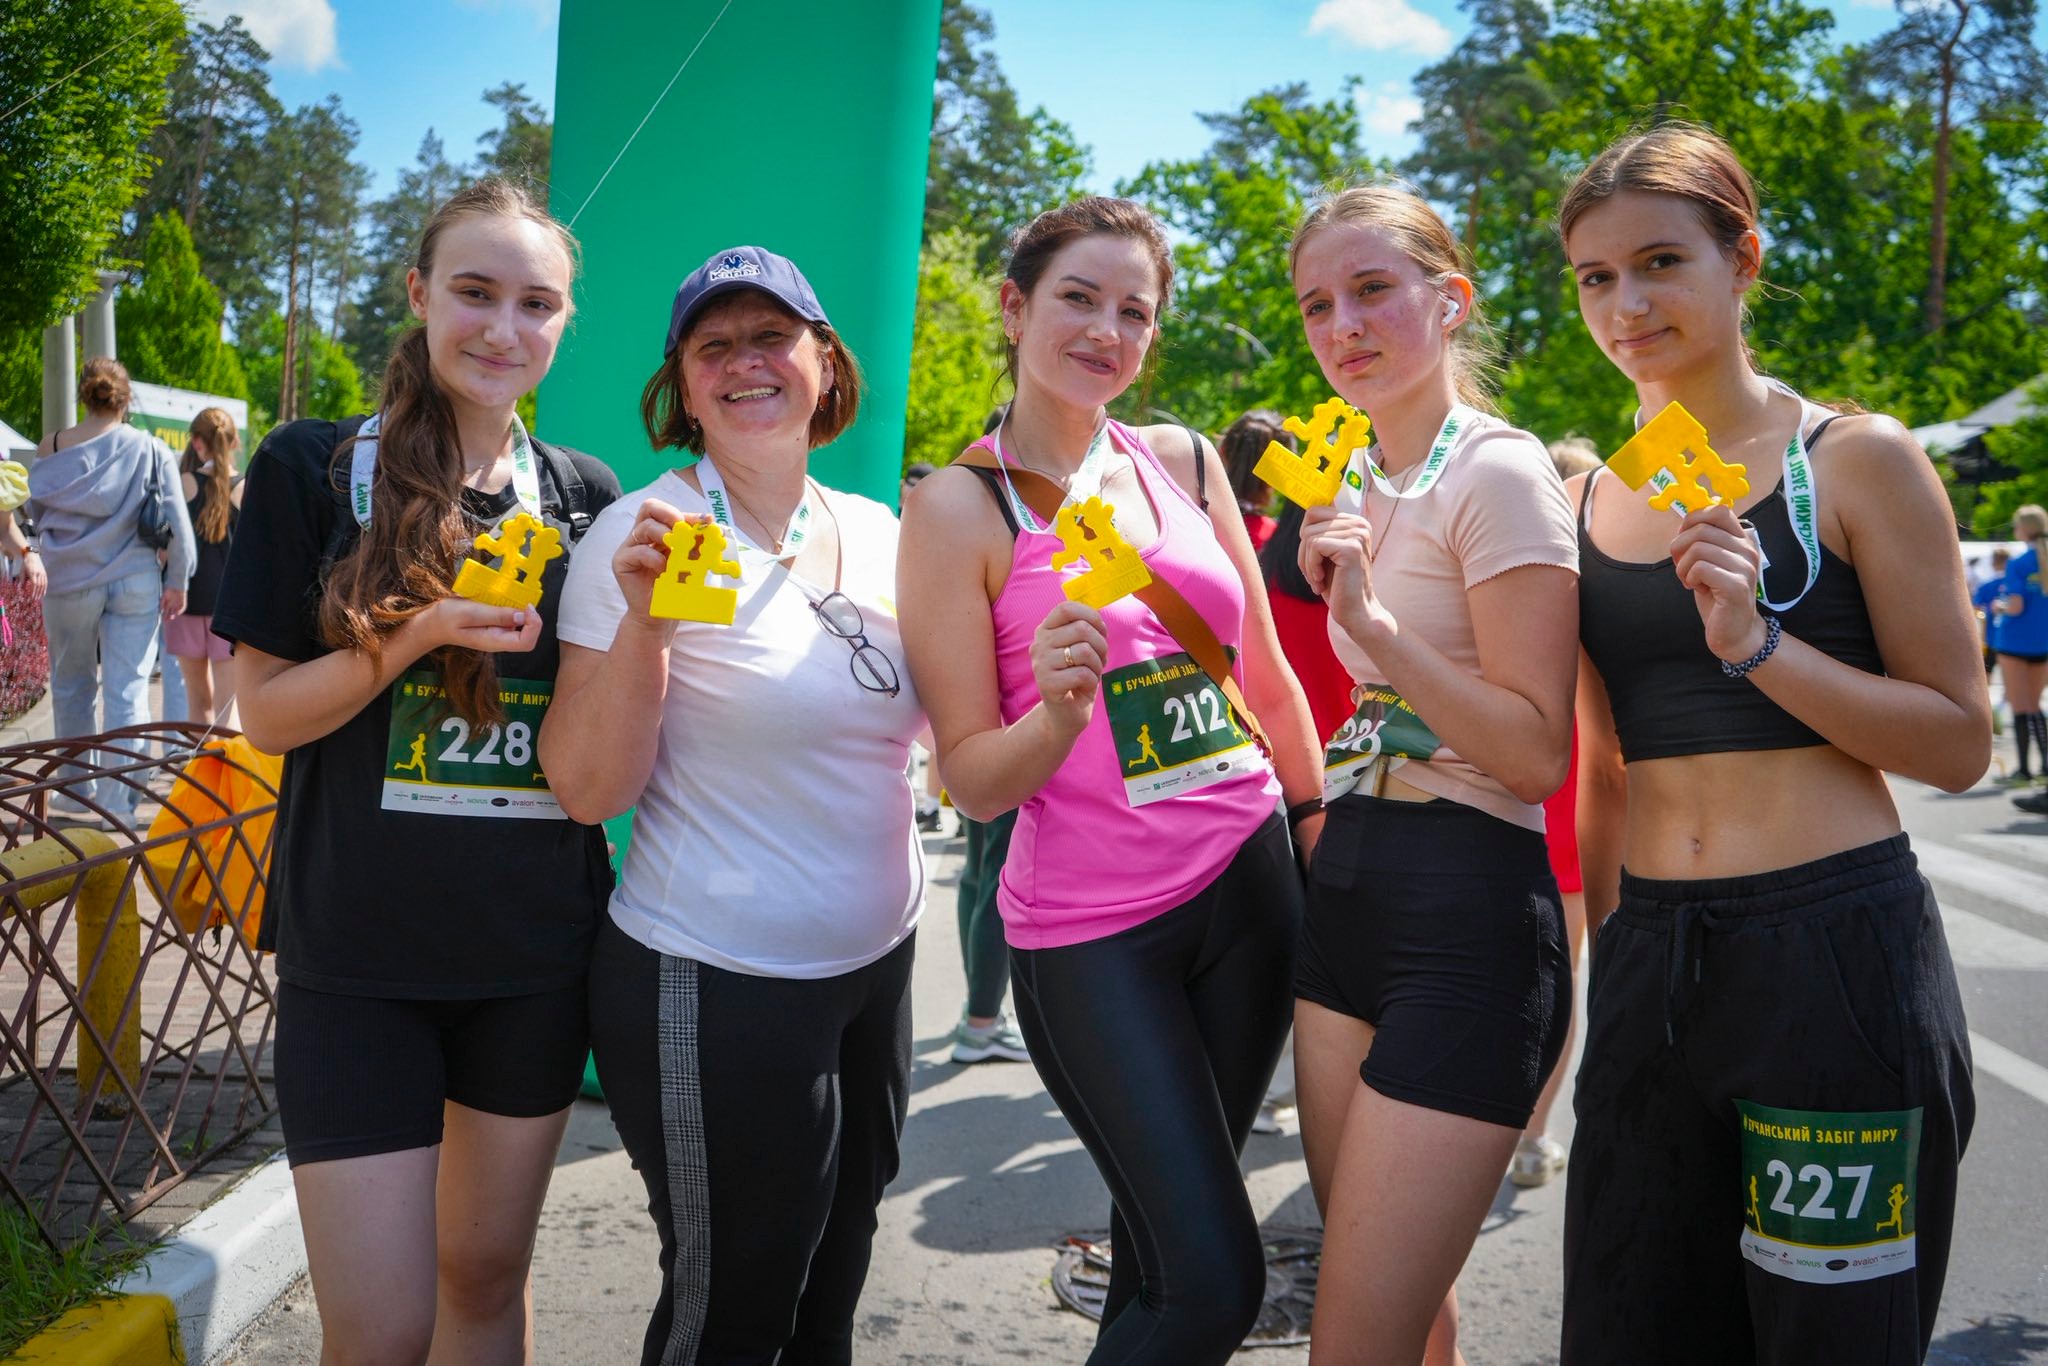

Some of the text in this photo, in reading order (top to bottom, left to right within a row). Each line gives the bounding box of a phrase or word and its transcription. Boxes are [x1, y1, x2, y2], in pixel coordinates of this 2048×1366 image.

[710, 266, 760, 281] Kappa
[1426, 446, 1448, 472] ЗАБІГ
[1789, 459, 1809, 492] ЗАБІГ
[1125, 664, 1181, 692] БУЧАНСЬКИЙ
[522, 693, 551, 706] МИРУ
[1163, 687, 1228, 744] 212
[437, 716, 532, 766] 228
[1816, 1130, 1855, 1144] ЗАБІГ
[1861, 1128, 1898, 1143] МИРУ
[1766, 1158, 1873, 1219] 227
[1796, 1258, 1822, 1269] NOVUS
[1852, 1256, 1879, 1268] avalon
